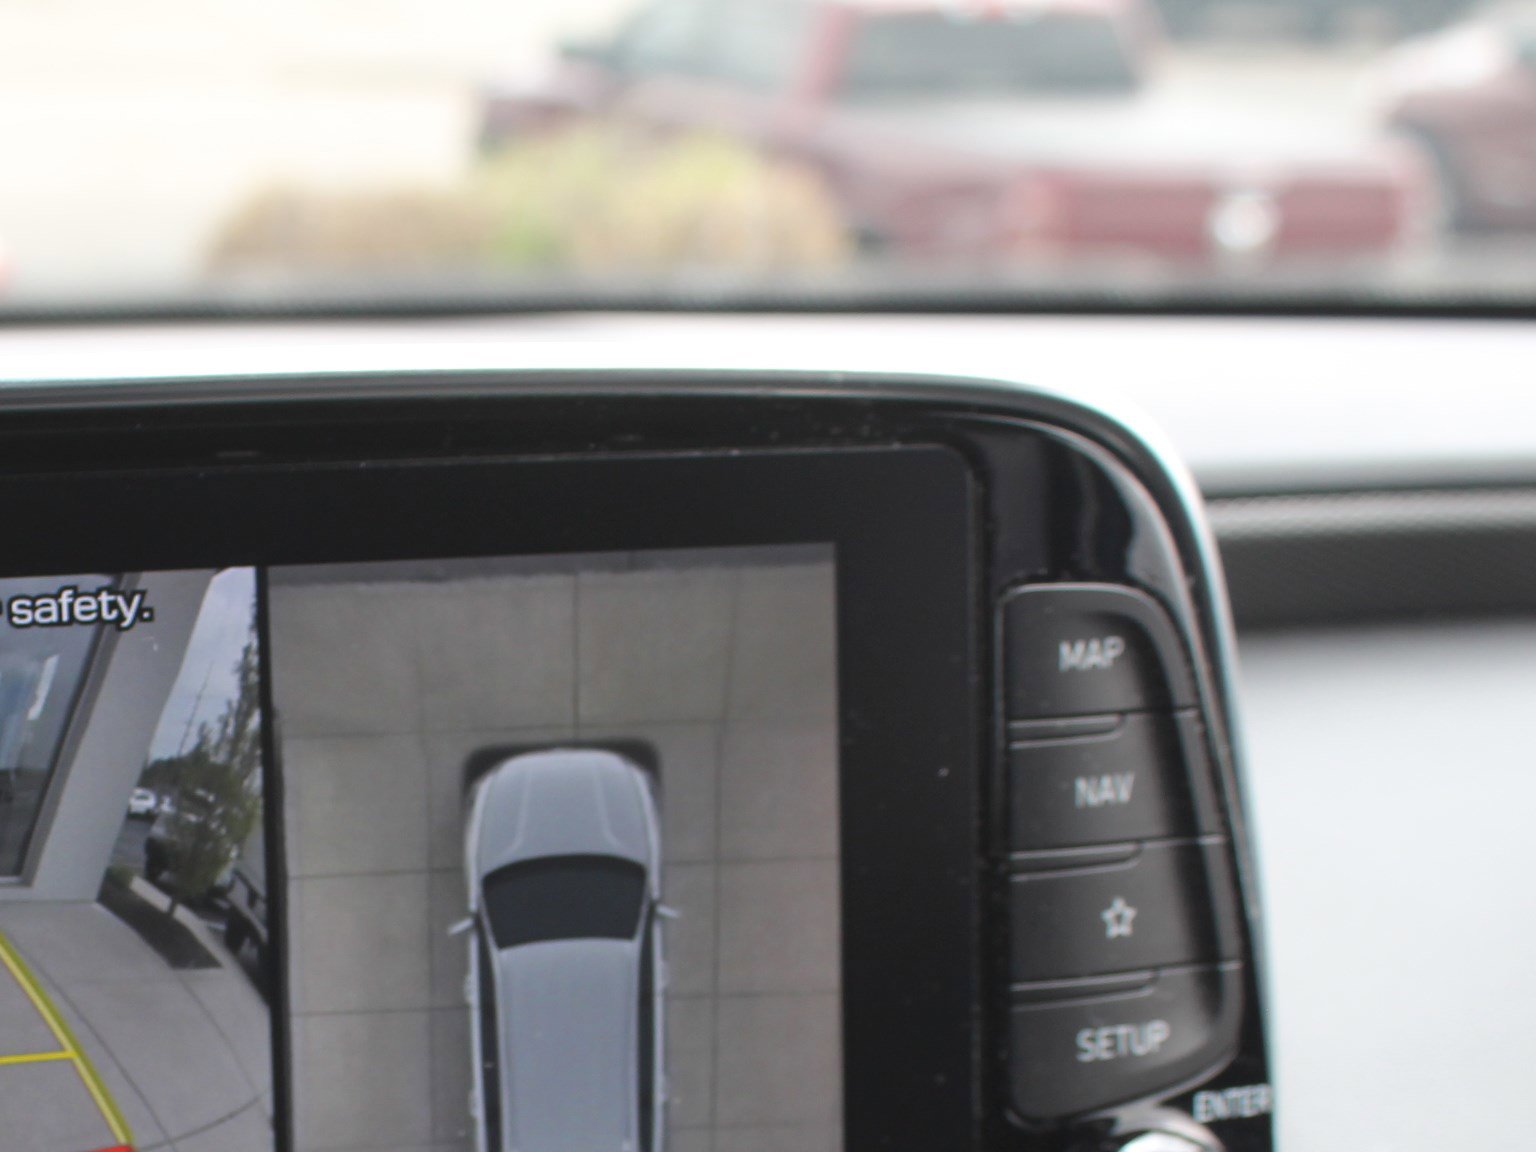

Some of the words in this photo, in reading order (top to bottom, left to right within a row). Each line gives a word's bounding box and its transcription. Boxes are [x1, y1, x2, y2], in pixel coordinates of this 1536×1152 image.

[10, 589, 153, 627] safety.
[1058, 635, 1126, 673] MAP
[1074, 772, 1135, 809] NAV
[1075, 1019, 1171, 1063] SETUP
[1192, 1082, 1274, 1124] ENTER
